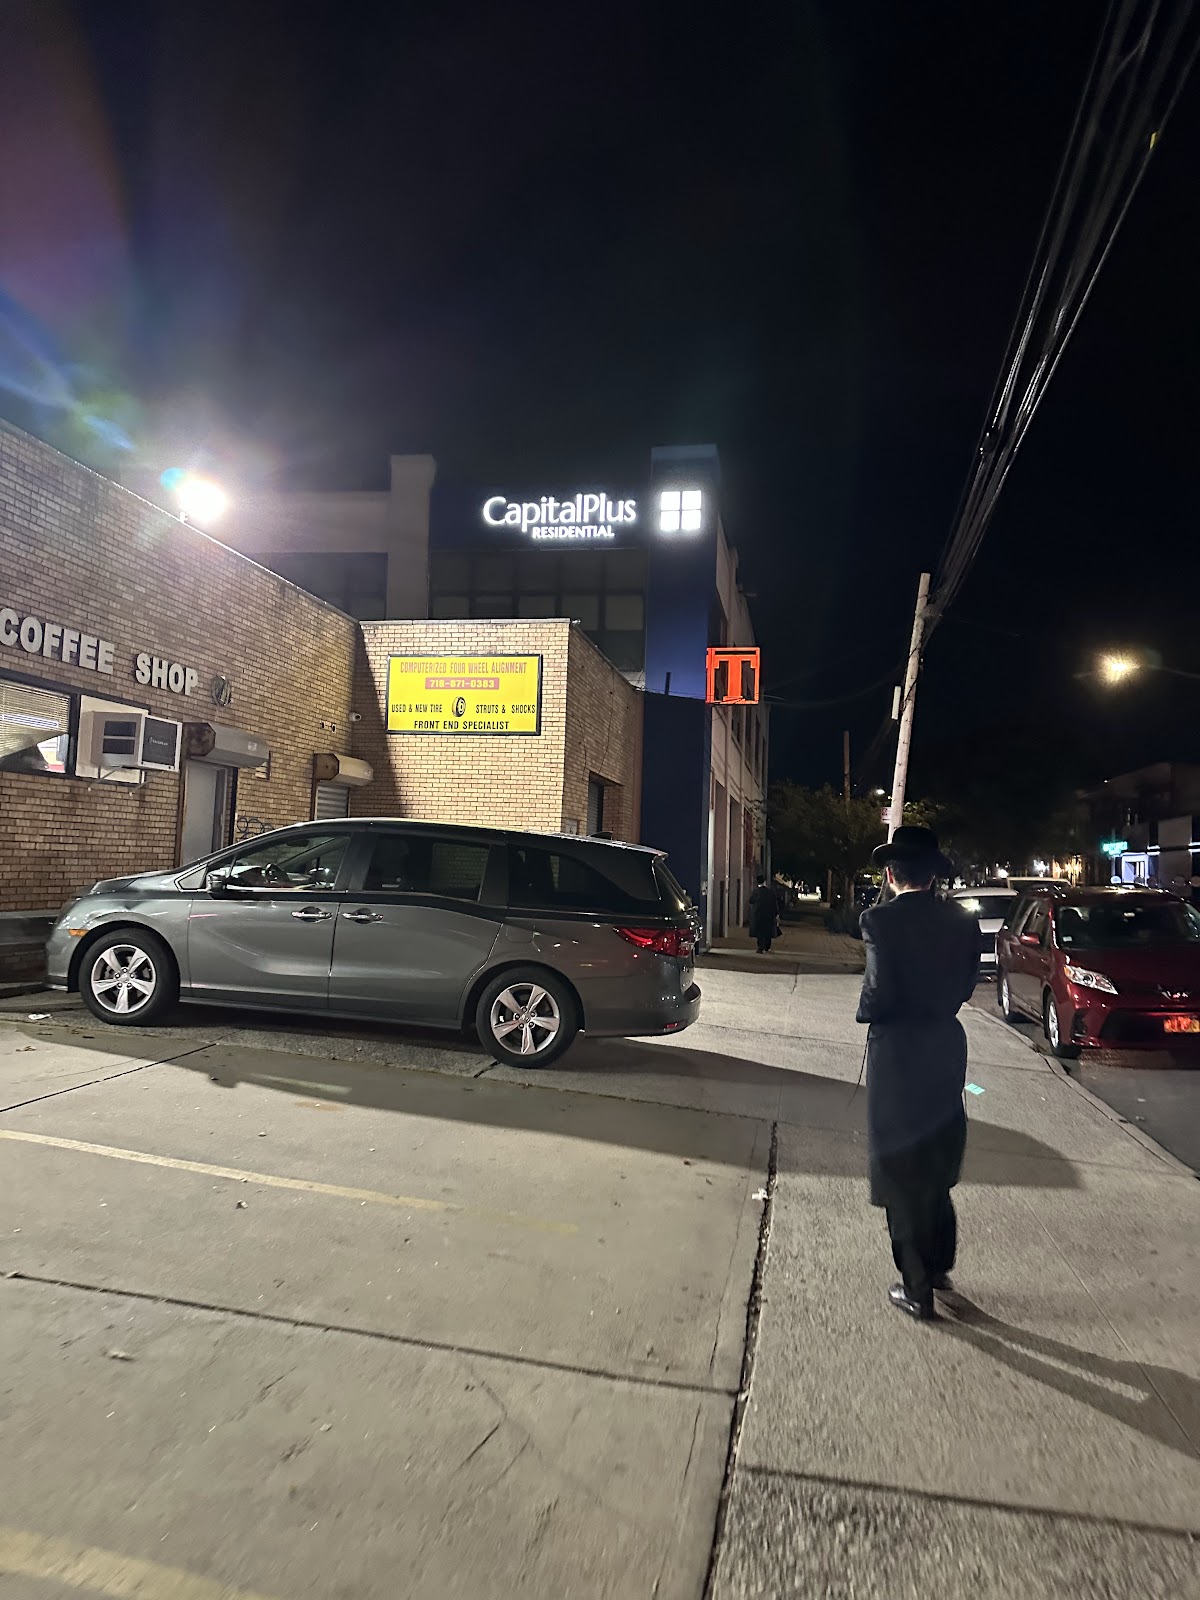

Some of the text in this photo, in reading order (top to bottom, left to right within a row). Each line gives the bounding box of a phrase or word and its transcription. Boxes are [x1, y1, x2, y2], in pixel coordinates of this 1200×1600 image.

[483, 493, 637, 532] CapitalPlus
[532, 525, 615, 539] RESIDENTIAL
[0, 607, 199, 696] COFFEE SHOP
[400, 662, 527, 673] COMPUTERIZED FOUR WHEEL ALIGNMENT
[430, 679, 495, 688] 718-871-0383
[391, 704, 443, 713] USED & NEW TIRE
[475, 704, 536, 714] STRUTS & SHOCKS
[414, 720, 510, 730] FRONT END SPECIALIST
